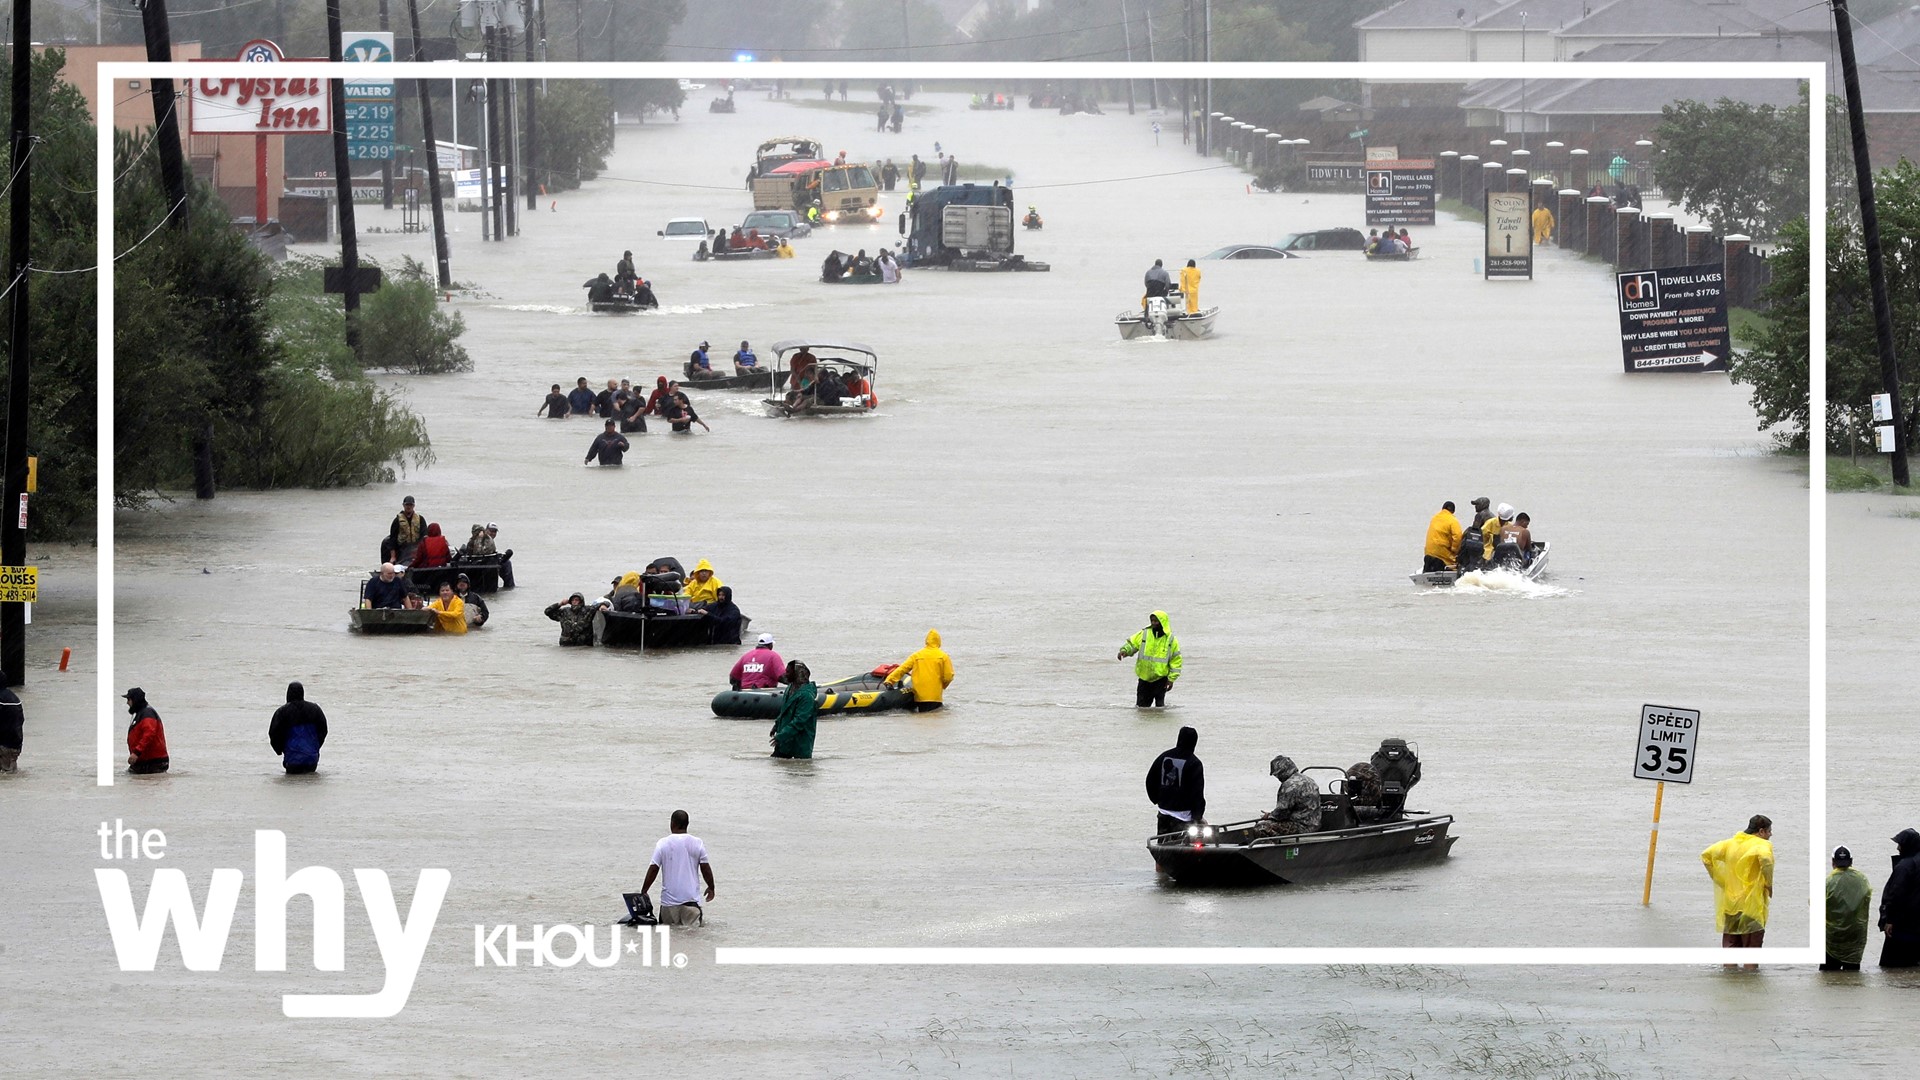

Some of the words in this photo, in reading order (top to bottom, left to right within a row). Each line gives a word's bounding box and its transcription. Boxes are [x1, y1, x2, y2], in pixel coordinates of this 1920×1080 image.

[345, 86, 391, 96] VALERO
[256, 98, 320, 127] Inn
[353, 189, 384, 199] ANCH
[1496, 216, 1522, 224] Tidwell
[1660, 275, 1695, 286] TIDWELL
[1696, 273, 1722, 283] LAKES
[1624, 275, 1654, 300] dh
[1696, 288, 1720, 297] $170s
[1626, 300, 1655, 309] Homes
[1649, 311, 1678, 319] PAYMENT
[1678, 307, 1717, 316] ASSISTANCE
[1642, 318, 1678, 327] PROGRAMS
[1622, 333, 1637, 341] WHY
[1644, 344, 1667, 352] CREDIT
[1687, 339, 1721, 348] WELCOME!
[1636, 356, 1701, 368] 844-91-HOUSE
[1, 574, 36, 585] OUSES
[1647, 713, 1693, 729] SPEED
[1651, 729, 1686, 743] LIMIT
[1641, 744, 1687, 775] 35
